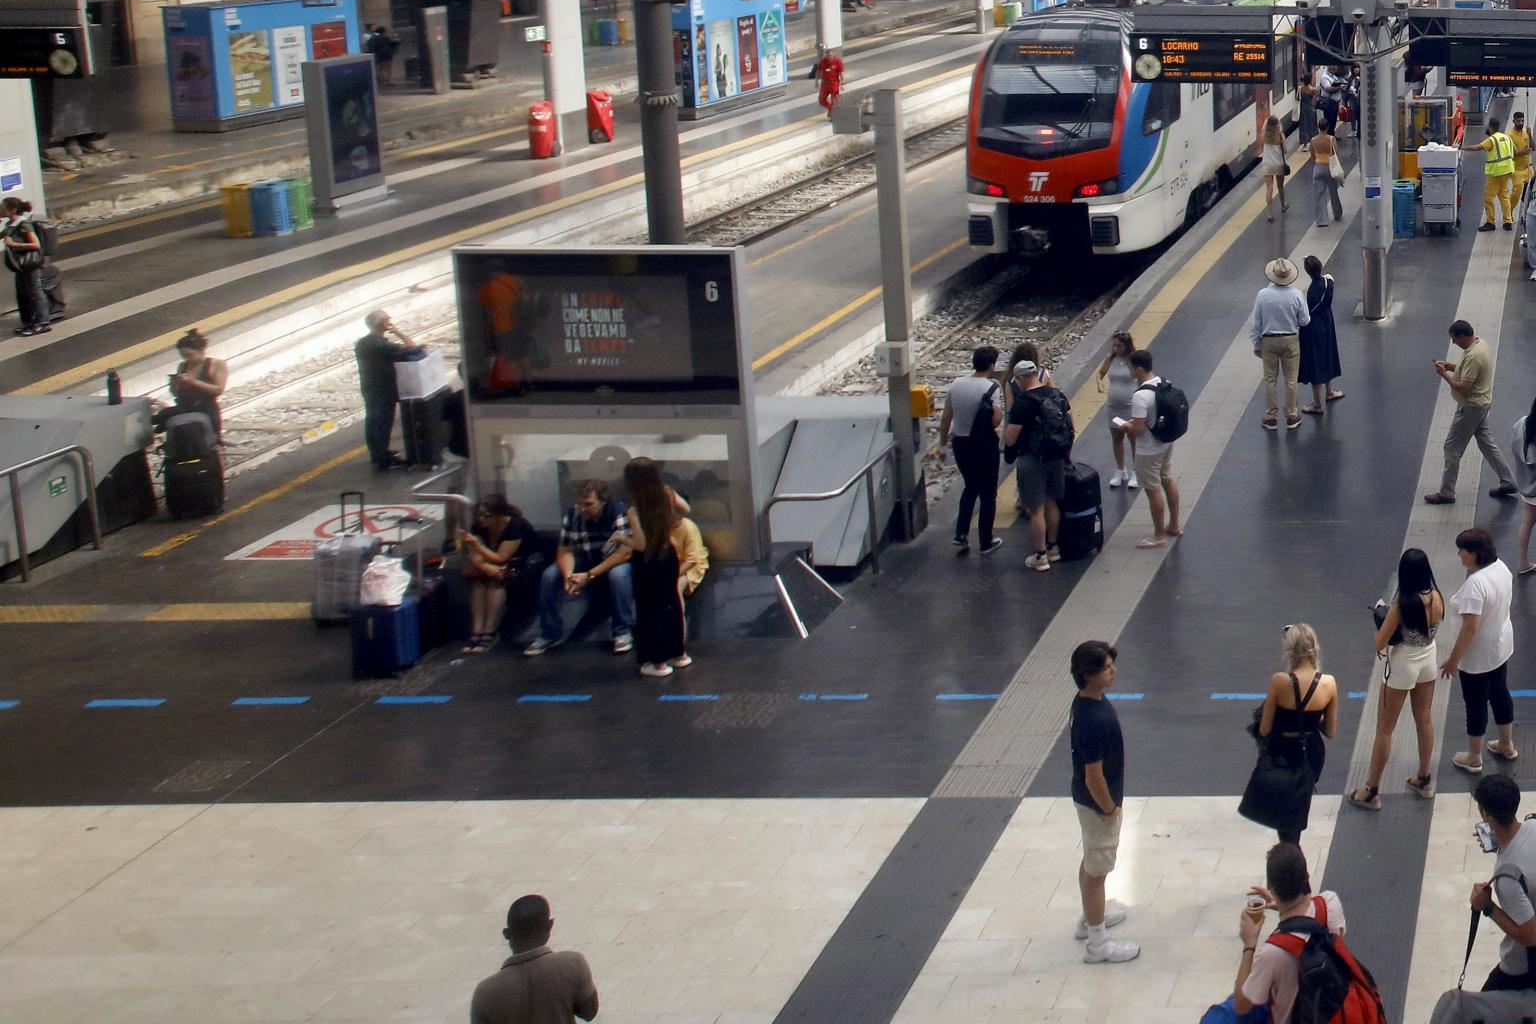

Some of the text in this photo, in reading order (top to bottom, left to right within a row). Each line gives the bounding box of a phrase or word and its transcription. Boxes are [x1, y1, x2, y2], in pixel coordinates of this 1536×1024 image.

[55, 33, 66, 45] 5
[1139, 38, 1148, 49] 6
[1161, 42, 1199, 51] LOCARNO
[1233, 52, 1244, 61] RE
[705, 280, 719, 302] 6
[562, 308, 625, 323] COME NON NE
[564, 324, 627, 338] VEDEVAMO
[565, 339, 582, 353] DA
[879, 355, 886, 364] 6
